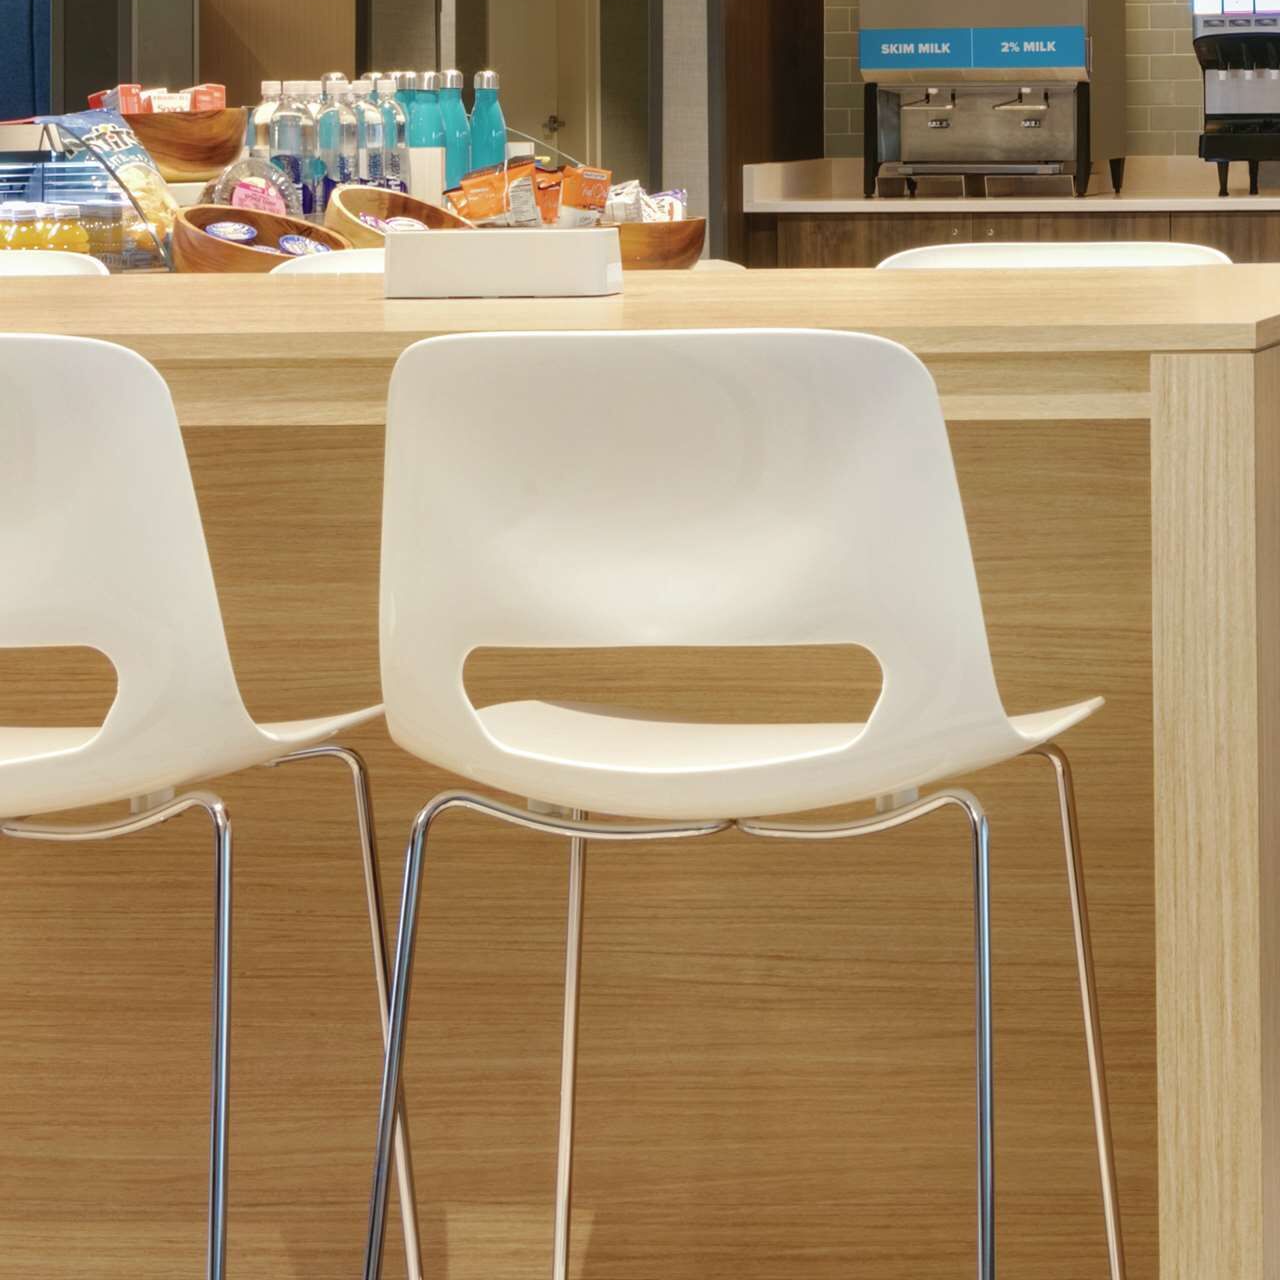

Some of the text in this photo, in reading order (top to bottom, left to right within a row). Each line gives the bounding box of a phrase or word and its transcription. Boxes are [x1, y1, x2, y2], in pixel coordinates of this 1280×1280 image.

[880, 43, 950, 55] SKIM MILK
[1000, 41, 1056, 53] 2% MILK
